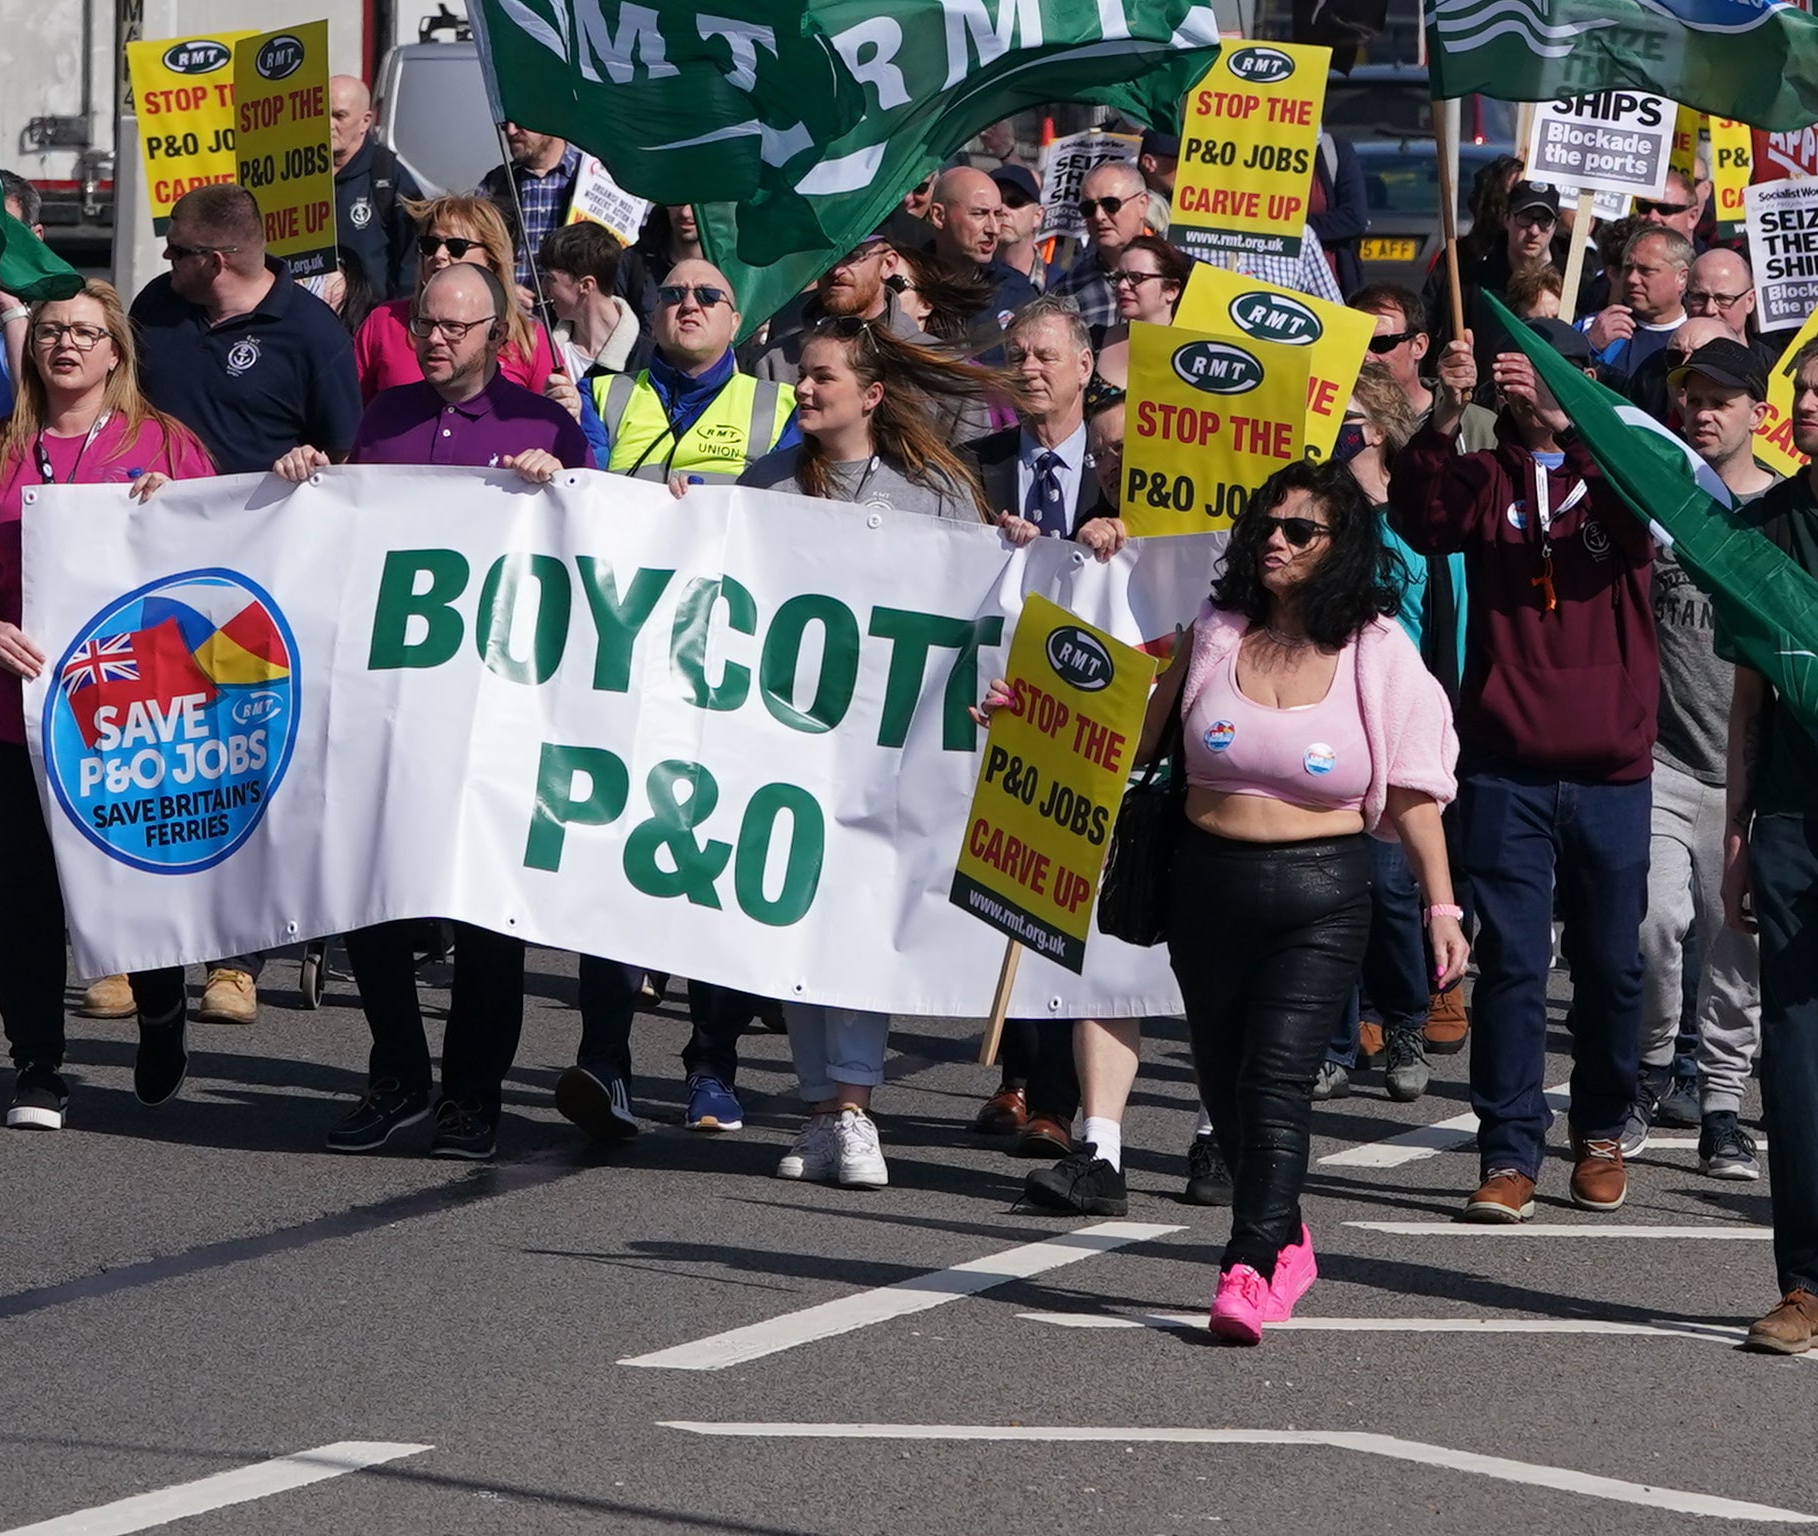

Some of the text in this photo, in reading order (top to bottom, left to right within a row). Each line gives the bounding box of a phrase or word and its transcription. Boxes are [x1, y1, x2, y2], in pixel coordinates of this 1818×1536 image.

[178, 49, 218, 66] RMT
[267, 47, 295, 69] RMT
[1241, 57, 1283, 74] RMT
[144, 85, 208, 115] STOP
[240, 96, 283, 133] STOP
[289, 85, 324, 119] THE
[1196, 91, 1313, 125] STOP THE
[1552, 89, 1663, 127] SHIPS
[147, 128, 236, 160] P&O JO
[1547, 122, 1652, 155] Blockade
[240, 143, 330, 188] P&O JOBS
[1055, 153, 1124, 173] SEIZ
[1185, 138, 1310, 174] P&O JOBS
[1545, 143, 1582, 165] the
[1584, 153, 1648, 178] ports
[1718, 148, 1749, 168] P&
[1053, 170, 1084, 188] TH
[1179, 186, 1302, 222] CARVE UP
[266, 201, 331, 243] RVE UP
[1185, 231, 1284, 253] www.rmt.org.uk
[1248, 306, 1307, 336] RMT
[1769, 298, 1802, 317] the
[1192, 355, 1247, 381] RMT
[706, 427, 738, 439] RMT
[1136, 401, 1294, 460] STOP THE
[698, 443, 741, 458] UNION
[1127, 467, 1248, 521] P&O JO
[1058, 641, 1102, 677] RMT
[93, 692, 210, 752] SAVE
[243, 698, 274, 719] RMT
[1009, 676, 1126, 774] STOP THE
[80, 728, 268, 797] P&O JOBS
[92, 780, 261, 829] SAVE BRITAIN'S
[984, 744, 1110, 847] P&O JOBS
[144, 814, 230, 848] FERRIES
[523, 742, 826, 928] P&O
[968, 817, 1091, 914] CARVE UP
[968, 887, 1067, 958] www.rmt.org.uk
